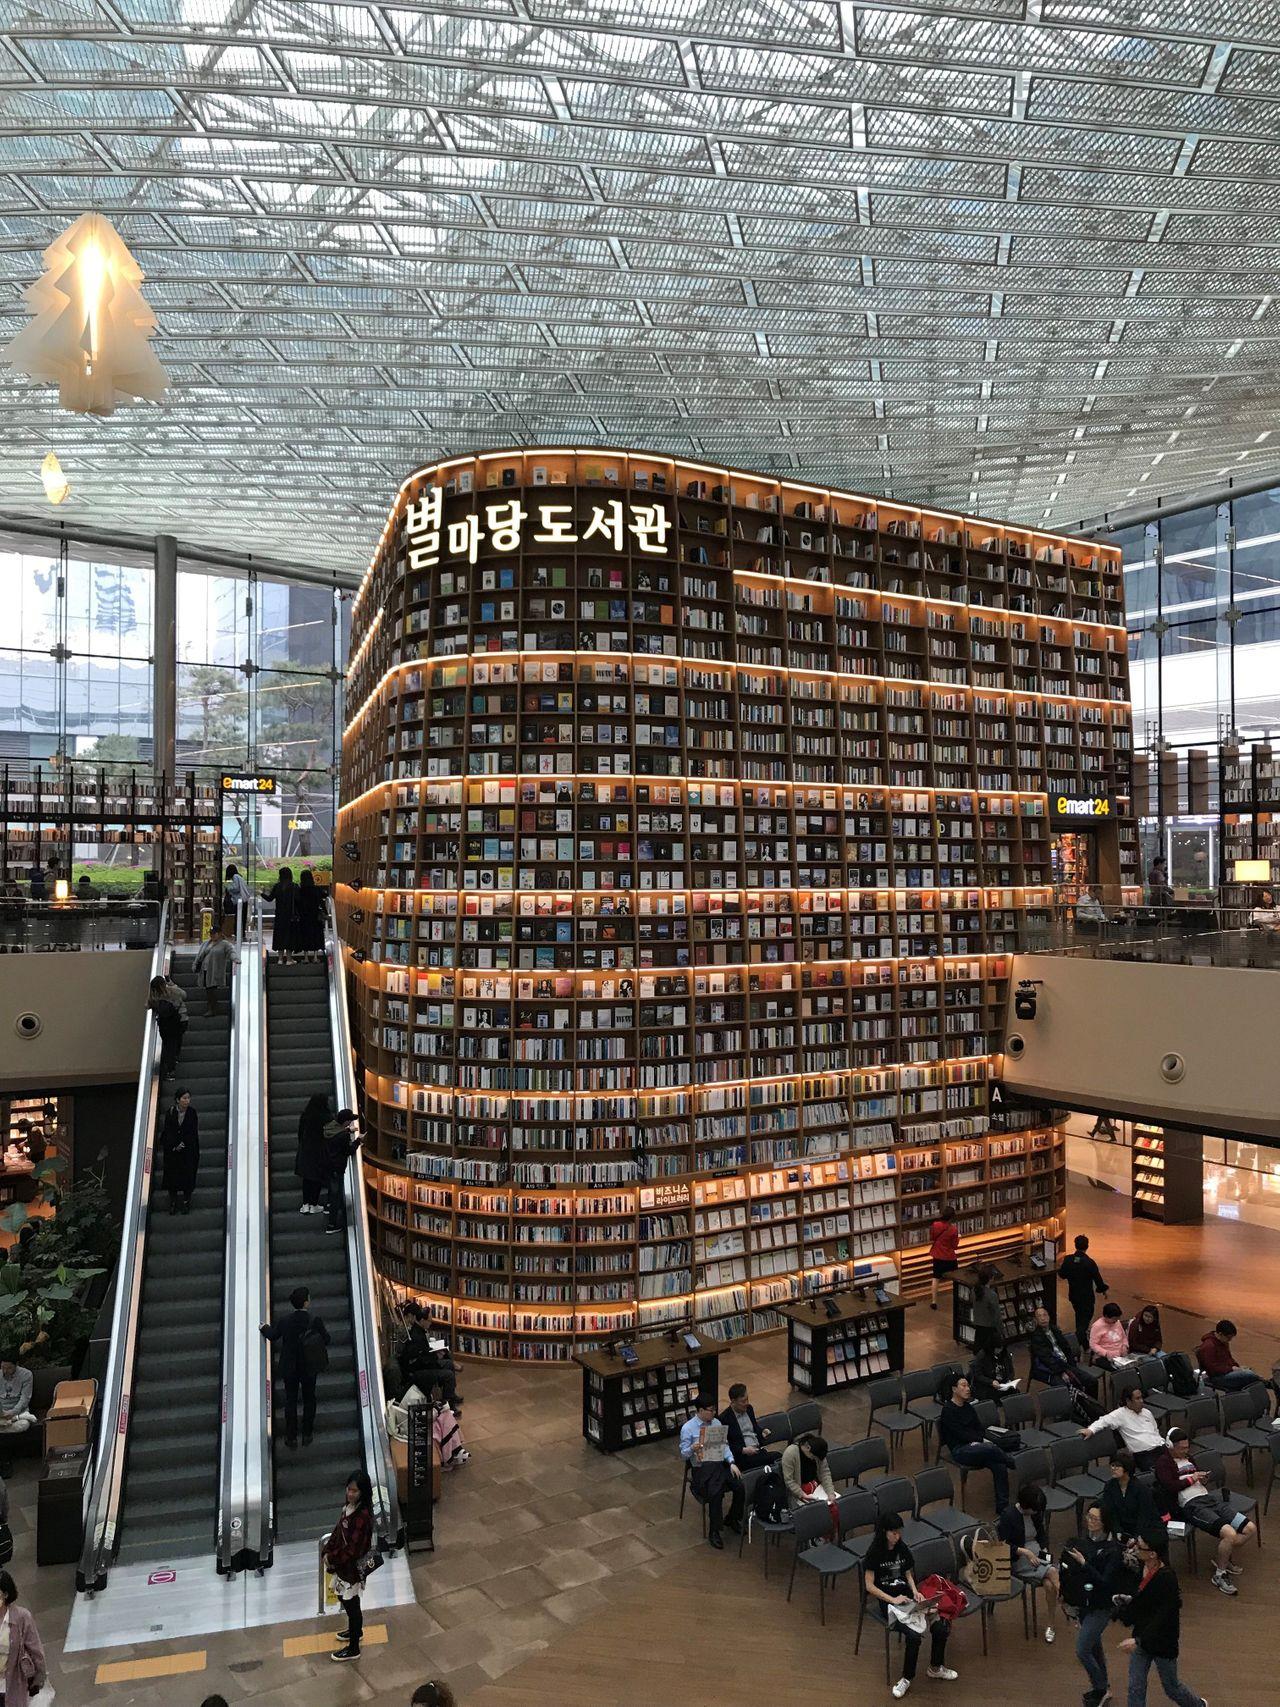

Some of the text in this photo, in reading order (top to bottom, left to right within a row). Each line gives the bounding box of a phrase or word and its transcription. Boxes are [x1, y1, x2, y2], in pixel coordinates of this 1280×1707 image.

[405, 486, 672, 570] 별마당 도서관
[222, 776, 274, 791] emart24
[1057, 796, 1110, 816] emart24
[991, 1086, 1003, 1103] A
[655, 1183, 690, 1197] 비즈니스
[655, 1192, 690, 1206] 라이브러리
